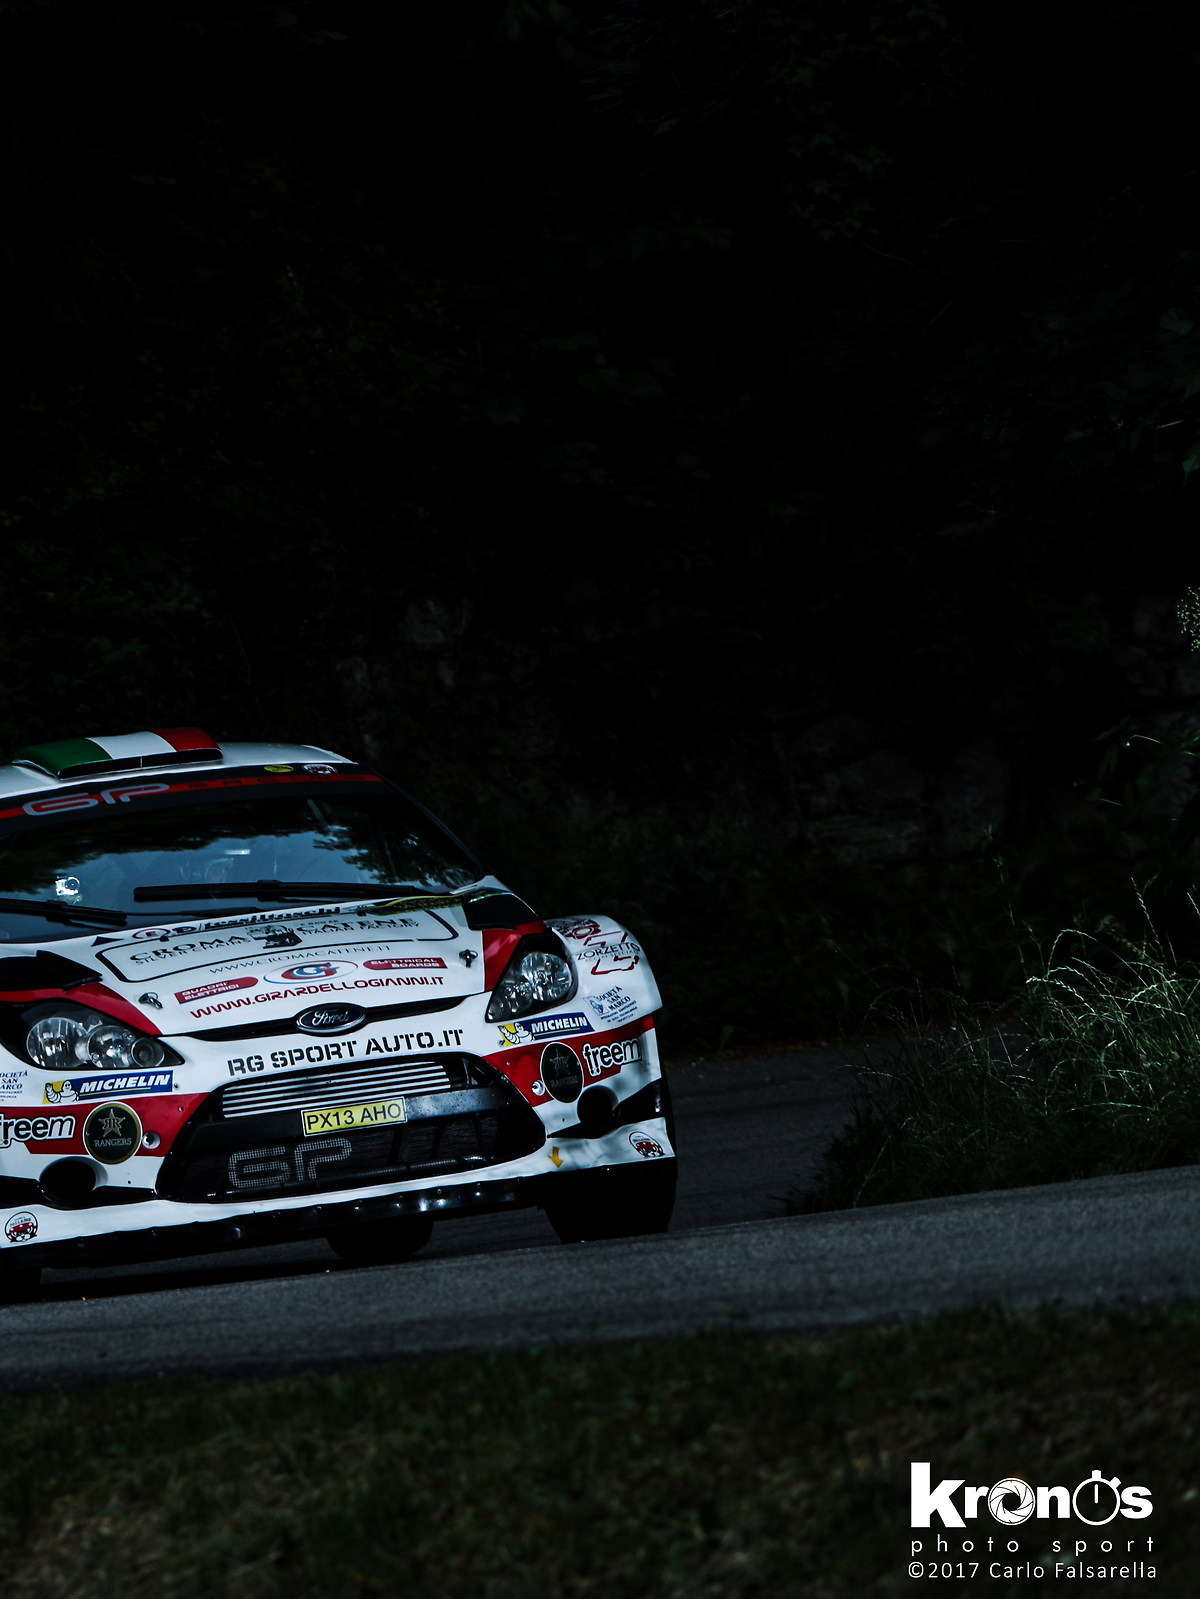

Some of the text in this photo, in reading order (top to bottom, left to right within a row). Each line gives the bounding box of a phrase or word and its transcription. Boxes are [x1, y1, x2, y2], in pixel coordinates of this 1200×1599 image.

[130, 936, 247, 961] CROMA
[297, 918, 415, 932] CATENE
[577, 941, 641, 961] ZORZETTO
[607, 994, 622, 1004] SAN
[607, 995, 631, 1011] MARCO
[311, 1008, 350, 1027] Ford
[531, 1016, 588, 1034] MICHELIN
[227, 1029, 464, 1076] RG SPORT AUTO.IT
[582, 1038, 642, 1077] freem
[79, 1073, 170, 1093] MICHELIN
[306, 1103, 401, 1130] PX13 AHO
[93, 1137, 132, 1147] RANGERS
